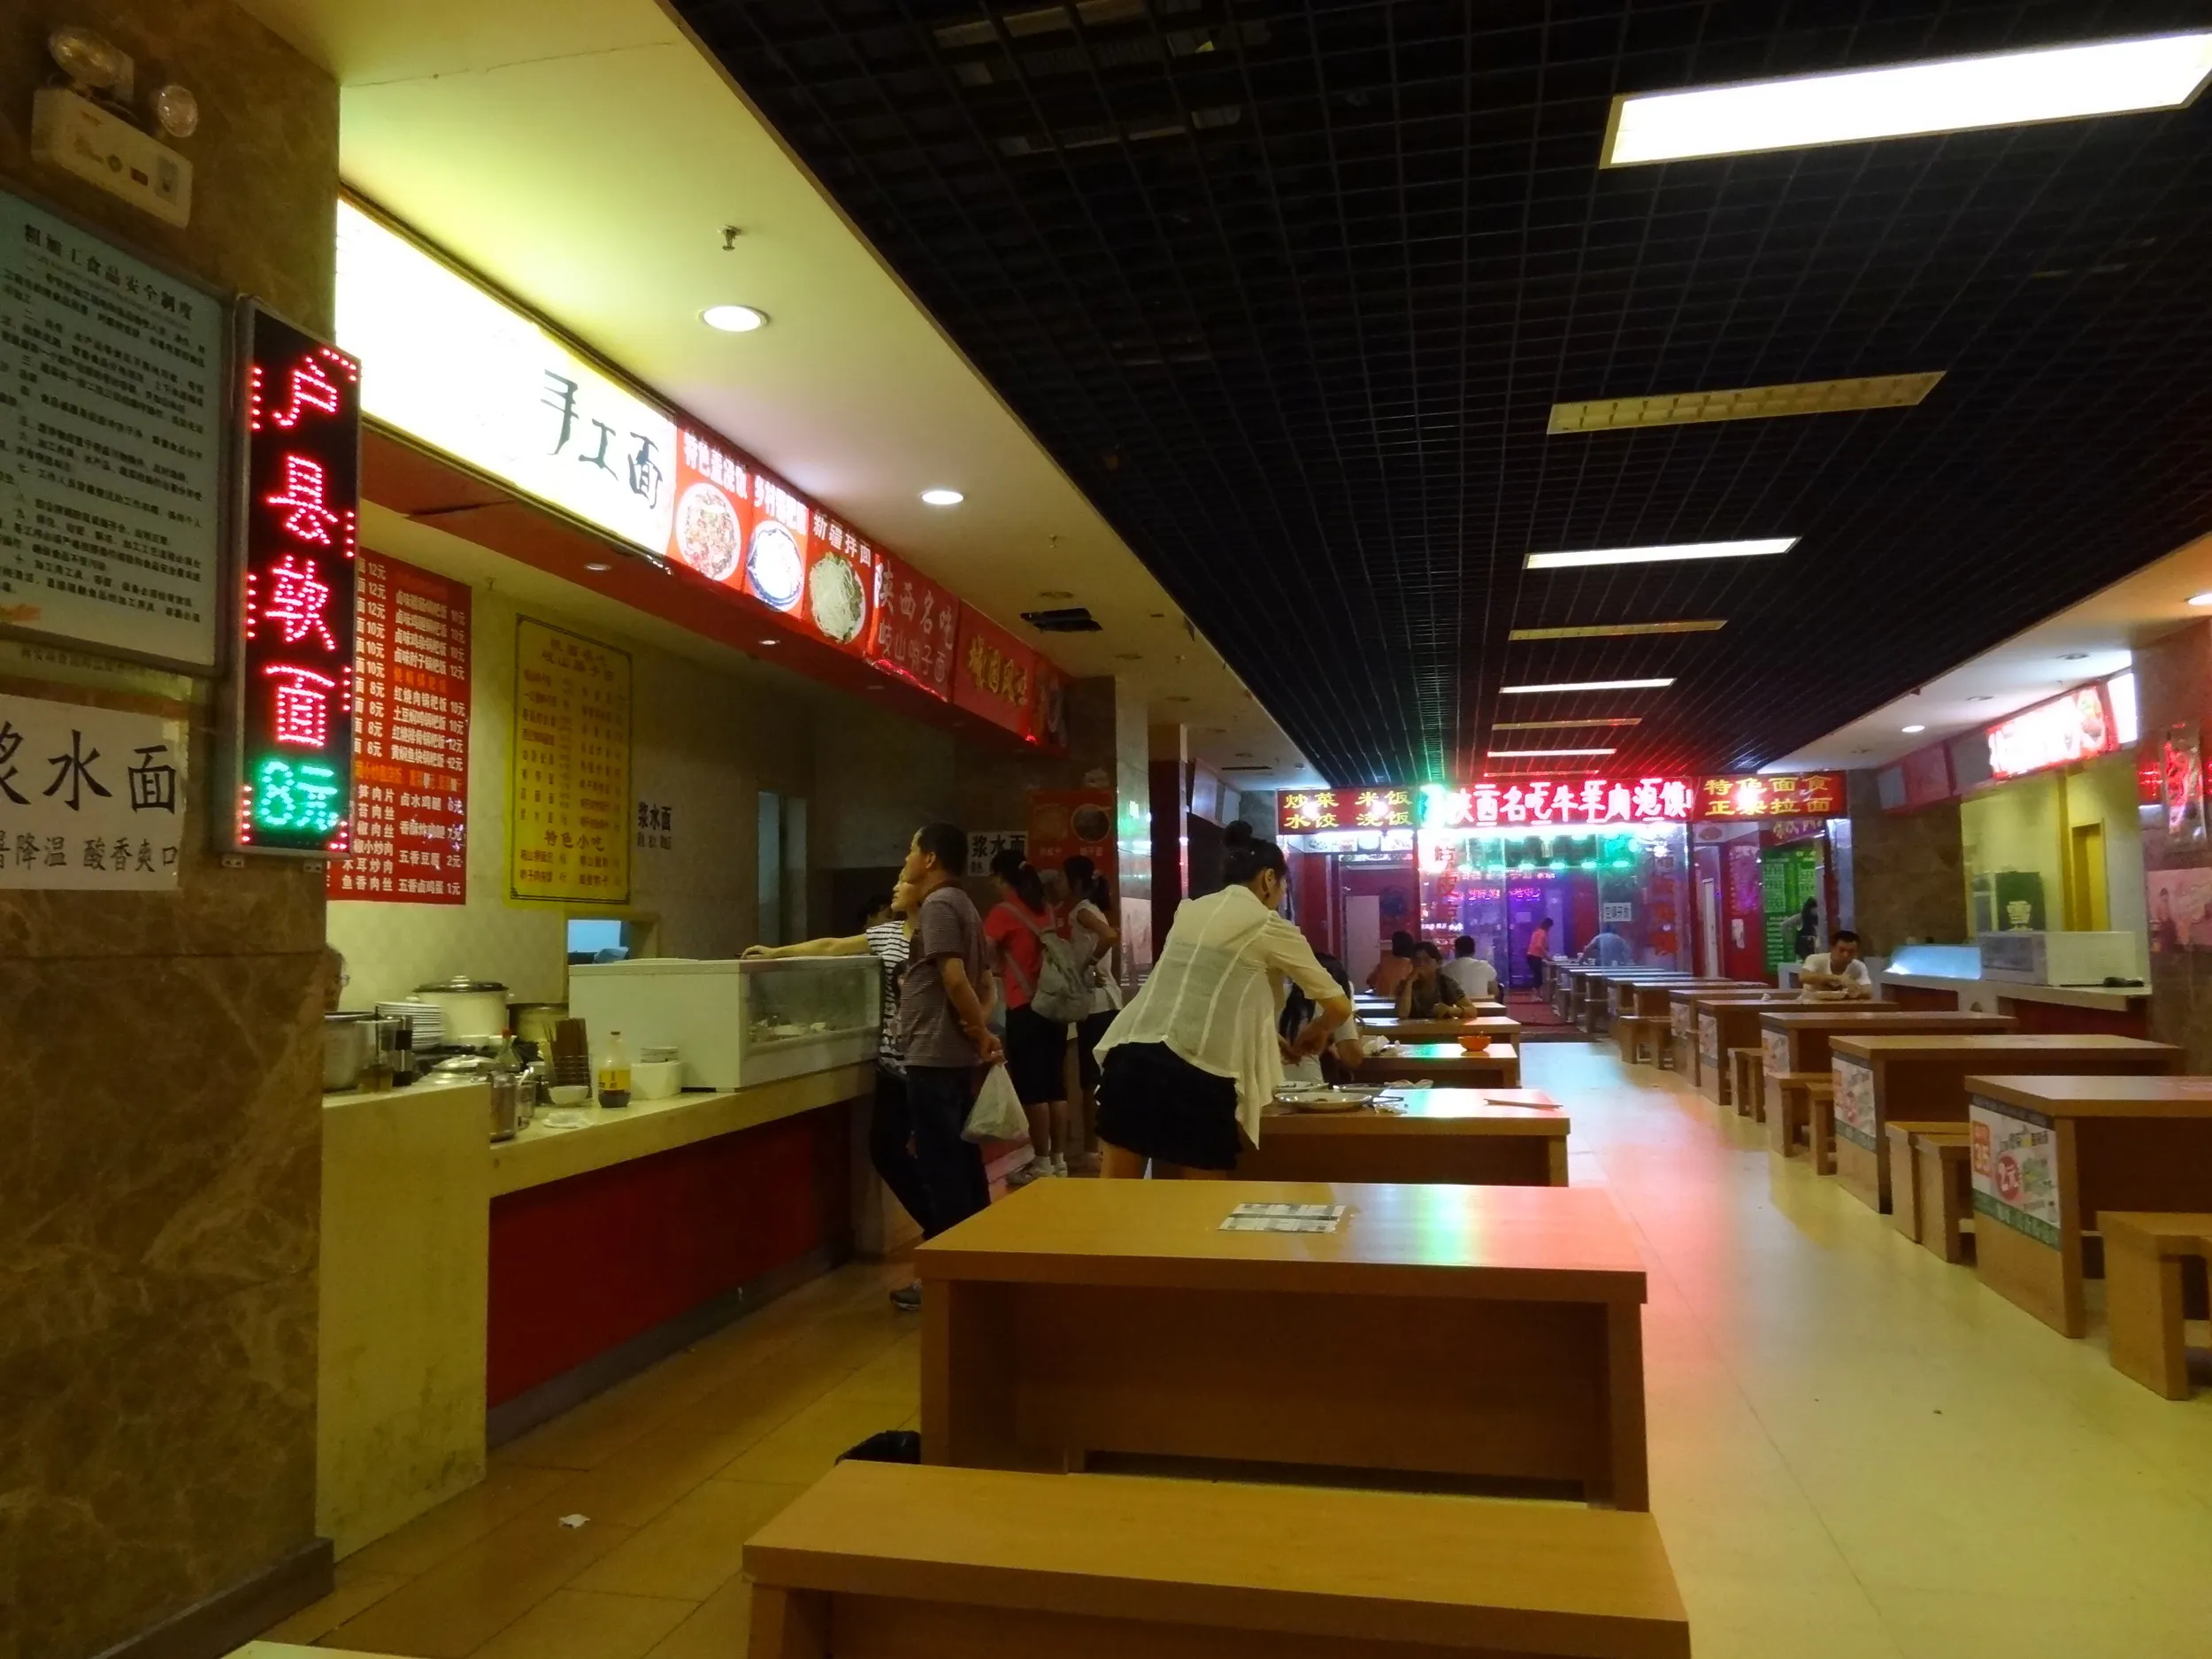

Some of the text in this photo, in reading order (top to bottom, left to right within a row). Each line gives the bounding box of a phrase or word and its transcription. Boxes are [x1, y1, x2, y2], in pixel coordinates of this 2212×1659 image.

[541, 369, 664, 511] 手工面
[813, 513, 872, 568] 新疆拌面
[265, 356, 339, 747] 户县软面
[357, 784, 395, 803] 笋肉片
[1703, 775, 1832, 795] 特色面食
[261, 760, 339, 831] 8元
[1284, 790, 1413, 809] 炒菜 米饭
[357, 803, 395, 820] 苔肉丝
[1284, 810, 1413, 828] 水饺 浇饭
[357, 820, 395, 838] 椒肉丝
[84, 838, 177, 873] 酸香爽口
[354, 839, 394, 856] 椒小炒肉
[447, 855, 461, 868] 2元
[342, 857, 393, 874] 木耳炒肉
[342, 875, 393, 892] 鱼香肉丝
[447, 882, 461, 895] 1元
